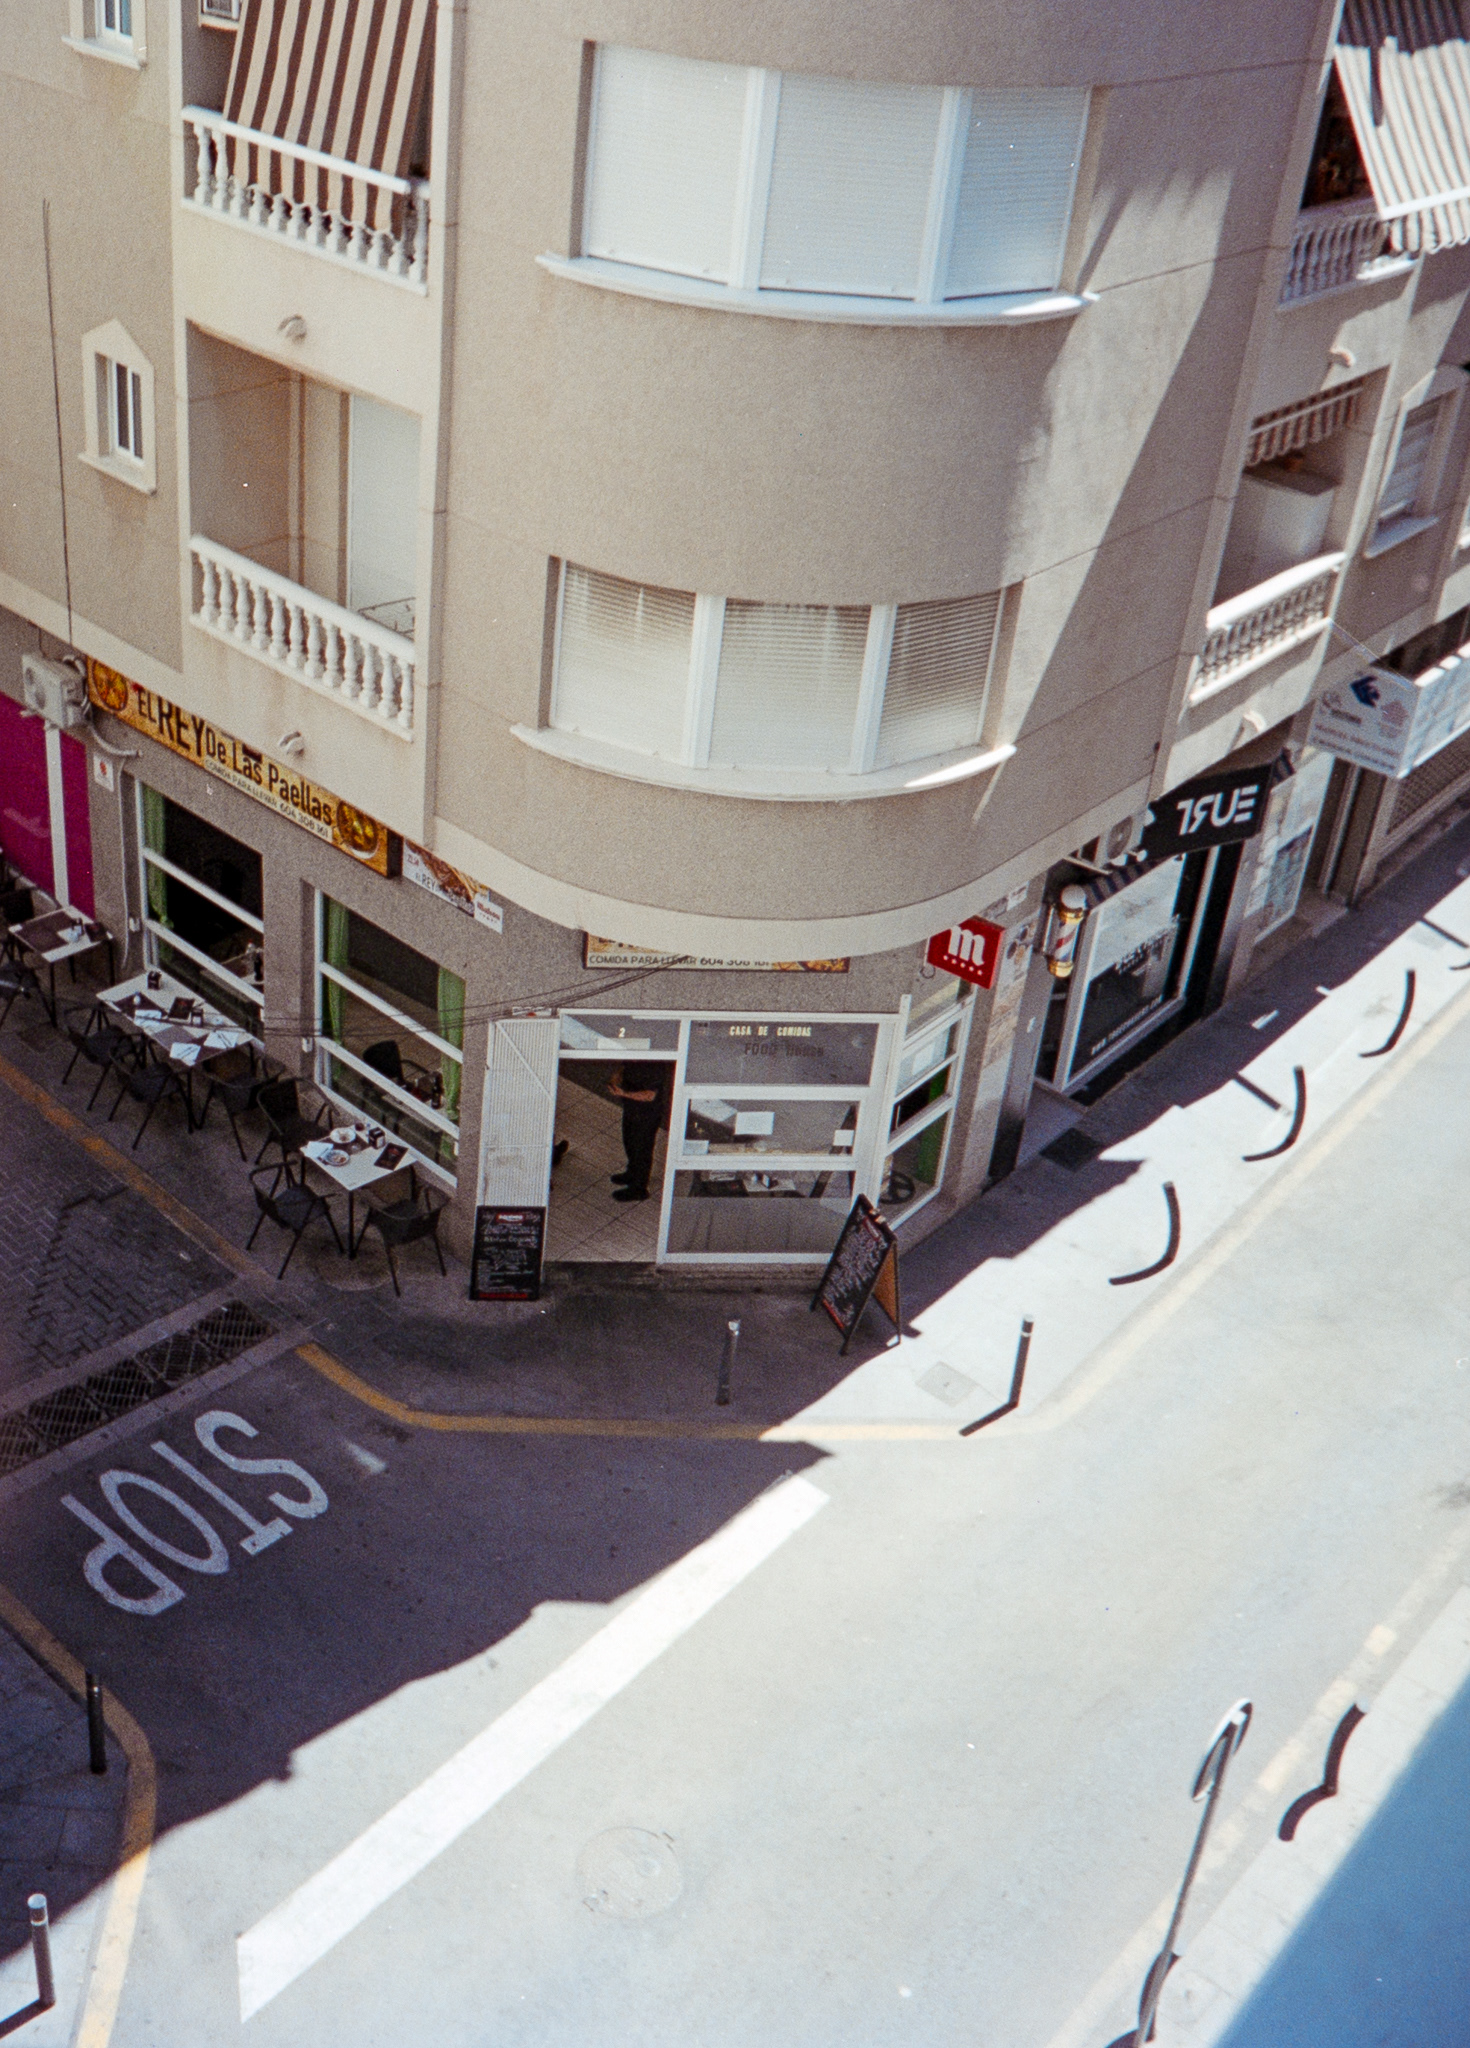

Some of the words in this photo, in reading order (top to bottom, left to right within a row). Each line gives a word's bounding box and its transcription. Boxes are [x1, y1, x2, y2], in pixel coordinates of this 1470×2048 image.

[157, 695, 205, 758] REY
[205, 725, 226, 765] De
[232, 740, 263, 786] Las
[268, 761, 333, 827] Paellas
[1176, 784, 1260, 836] TRUE
[588, 953, 629, 965] COMIDA
[630, 954, 659, 966] PARA
[729, 1025, 752, 1036] CASA
[757, 1025, 769, 1037] DE
[776, 1026, 812, 1037] COMIDAS
[60, 1410, 329, 1616] STOP
